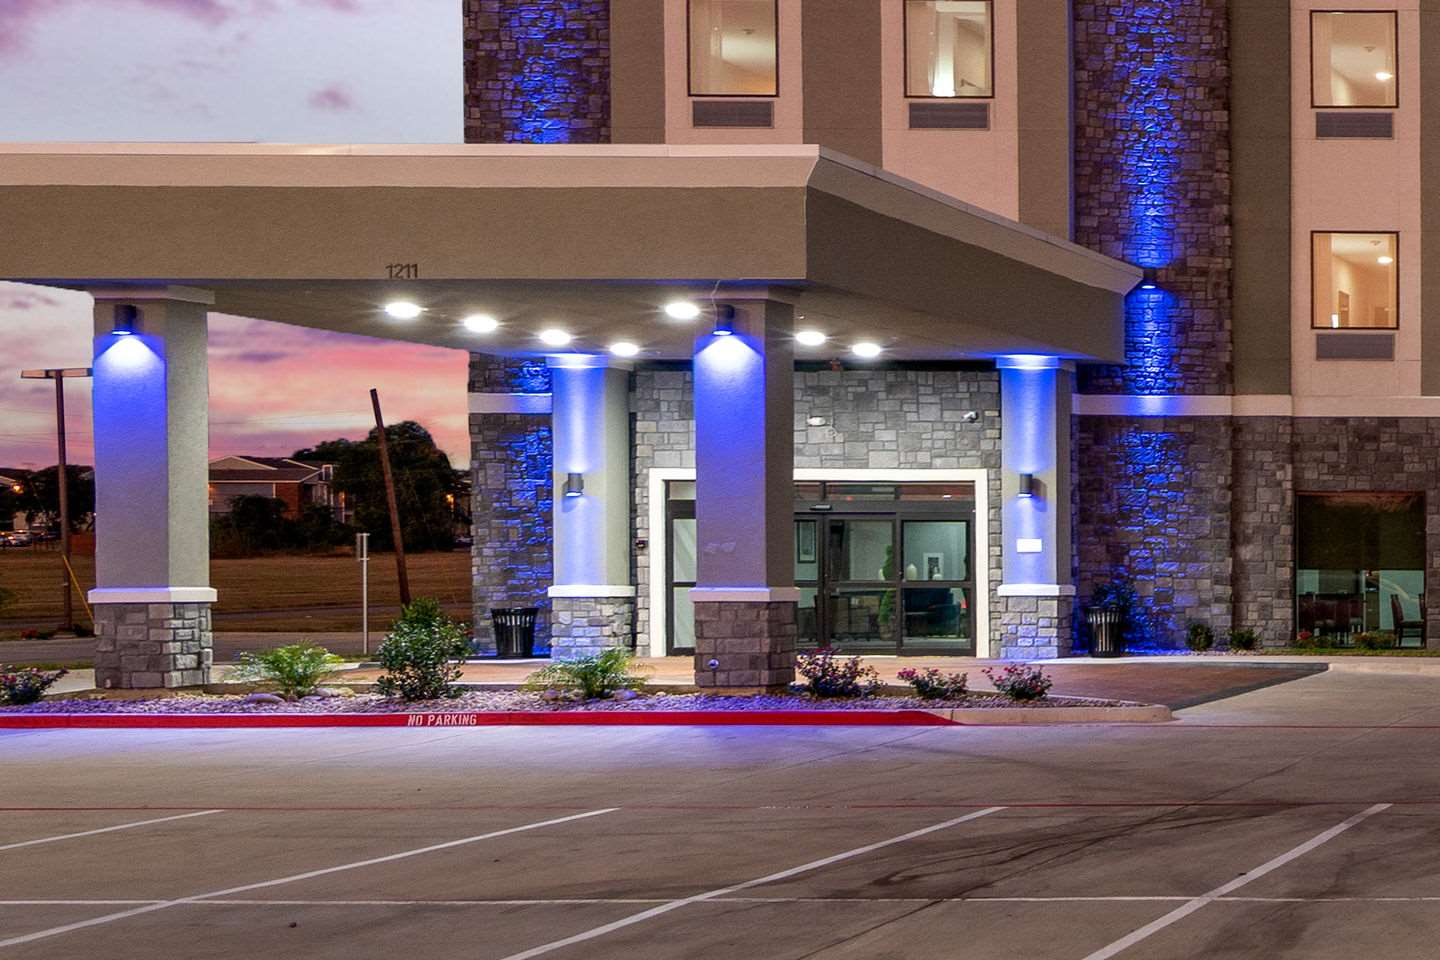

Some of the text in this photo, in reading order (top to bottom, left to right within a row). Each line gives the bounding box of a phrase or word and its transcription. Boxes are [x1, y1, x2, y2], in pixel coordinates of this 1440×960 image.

[385, 263, 418, 279] 1211
[408, 714, 477, 726] NO PARKING
